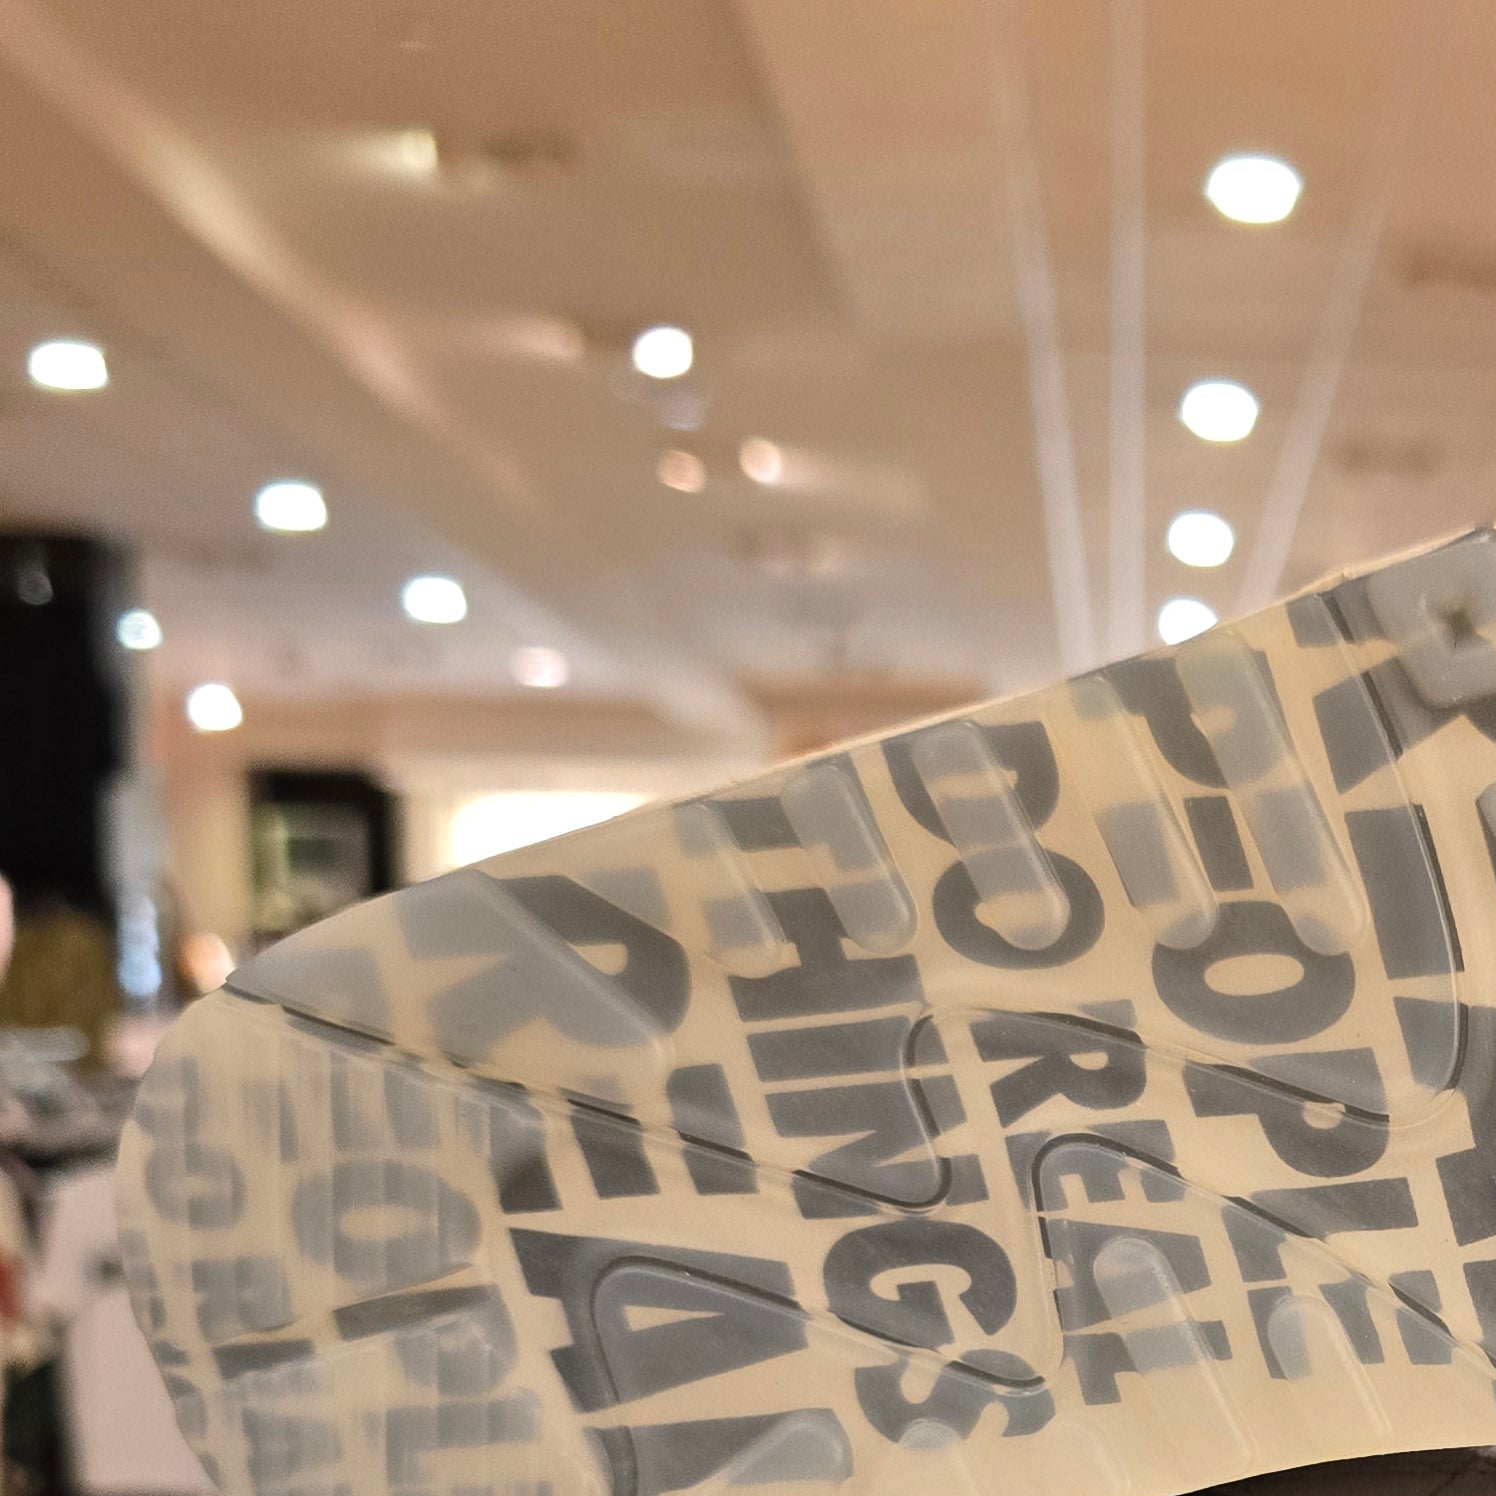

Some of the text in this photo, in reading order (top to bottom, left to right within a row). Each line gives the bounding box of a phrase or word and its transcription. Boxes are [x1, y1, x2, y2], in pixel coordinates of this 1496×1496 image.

[672, 746, 1057, 1450] THINGS
[882, 719, 1231, 1407] DO REAL
[1067, 648, 1454, 1382] PEOPLE
